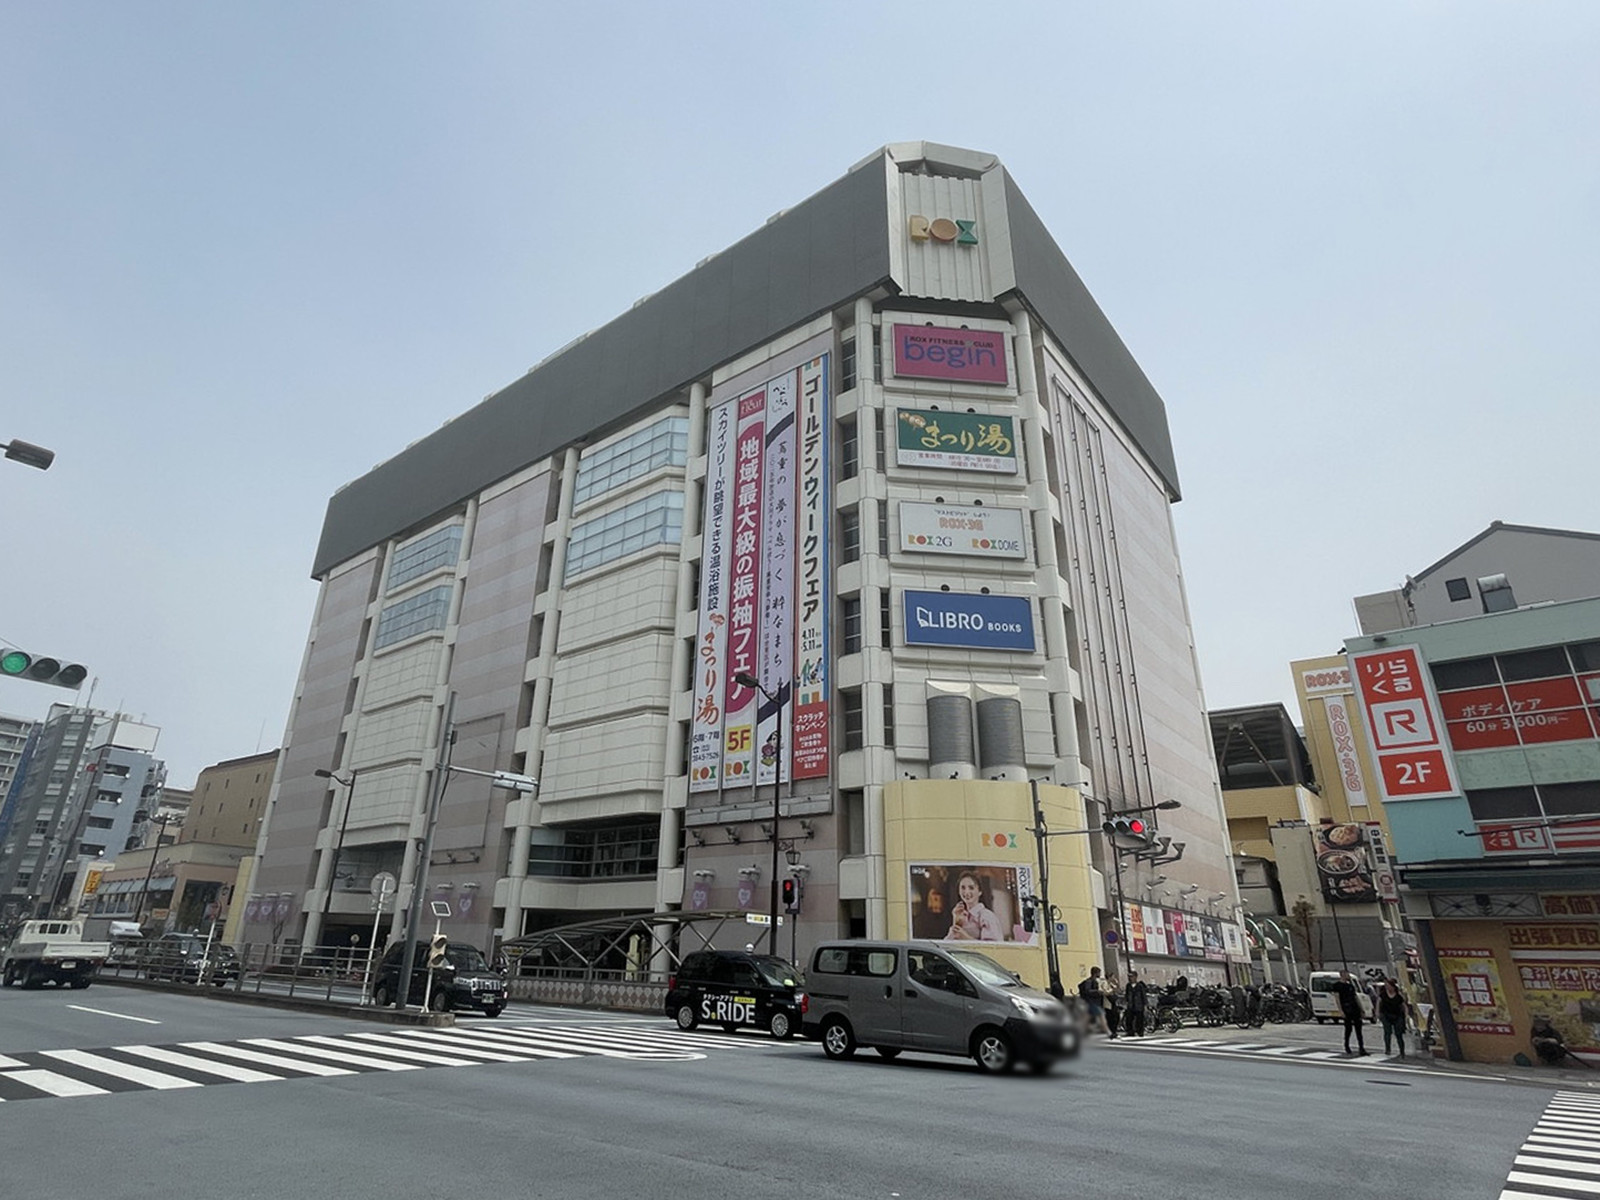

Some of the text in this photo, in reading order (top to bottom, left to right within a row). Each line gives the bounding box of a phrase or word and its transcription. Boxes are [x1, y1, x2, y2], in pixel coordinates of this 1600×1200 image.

[909, 215, 979, 244] ROX
[904, 335, 997, 368] begin
[921, 420, 1012, 455] まつり湯
[802, 374, 821, 622] ゴールデンウィークフェア
[936, 536, 953, 547] 2G
[731, 436, 760, 700] 地域最大級の振袖フェア
[928, 611, 1022, 632] LIBRO BOOKS
[696, 626, 719, 725] まつり湯
[1366, 659, 1408, 677] りら
[1372, 677, 1413, 694] くる
[1462, 698, 1542, 717] ボディケア
[796, 720, 827, 732] キャンペーン
[797, 711, 824, 723] スクラッチ
[1384, 709, 1418, 736] R
[1466, 721, 1497, 733] 60分
[728, 729, 751, 752] 5F
[692, 766, 716, 781] ROX
[725, 760, 750, 777] ROX
[1396, 761, 1432, 785] 2F
[981, 833, 1017, 848] ROX
[1519, 830, 1537, 843] R
[1508, 927, 1599, 945] 出張買取
[1552, 967, 1579, 981] ダイヤ
[701, 1000, 756, 1024] S.RIDE
